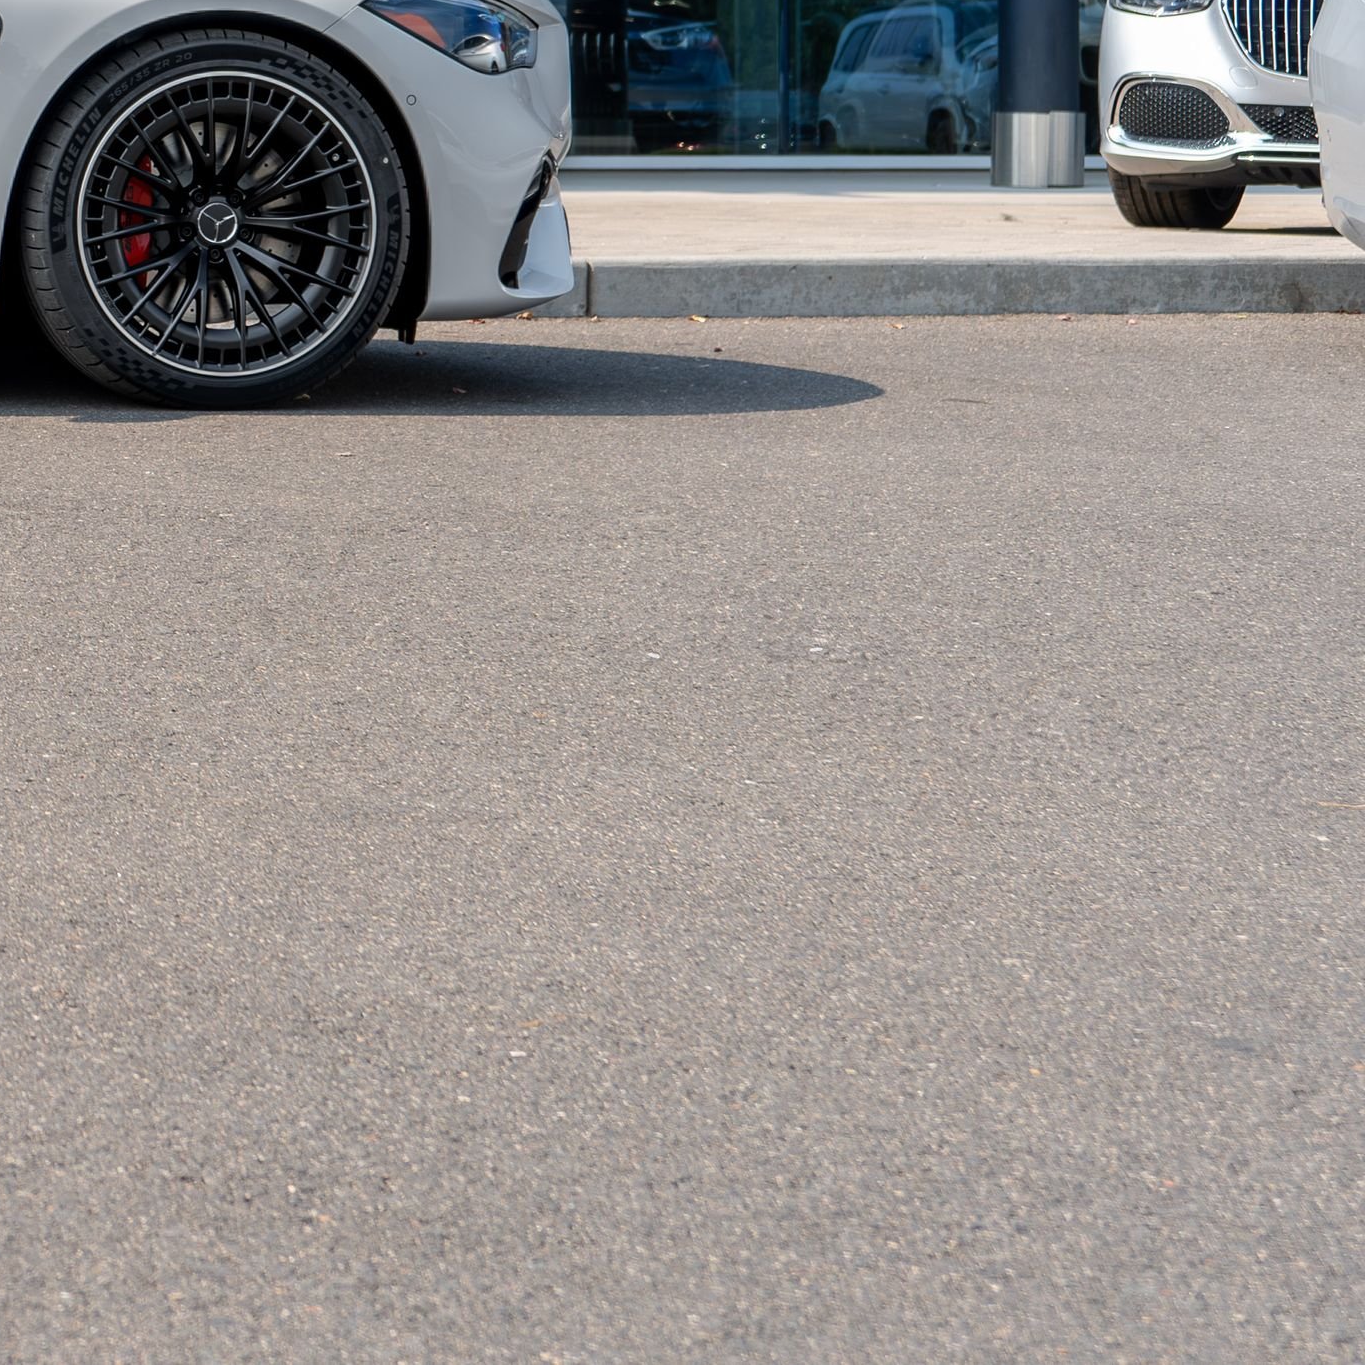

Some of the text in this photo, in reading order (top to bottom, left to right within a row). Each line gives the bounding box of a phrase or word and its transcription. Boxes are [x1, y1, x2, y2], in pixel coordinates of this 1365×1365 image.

[52, 107, 103, 218] MICHELIN
[107, 67, 151, 104] 265/35
[175, 52, 193, 64] 20
[353, 230, 400, 338] MICHELIN
